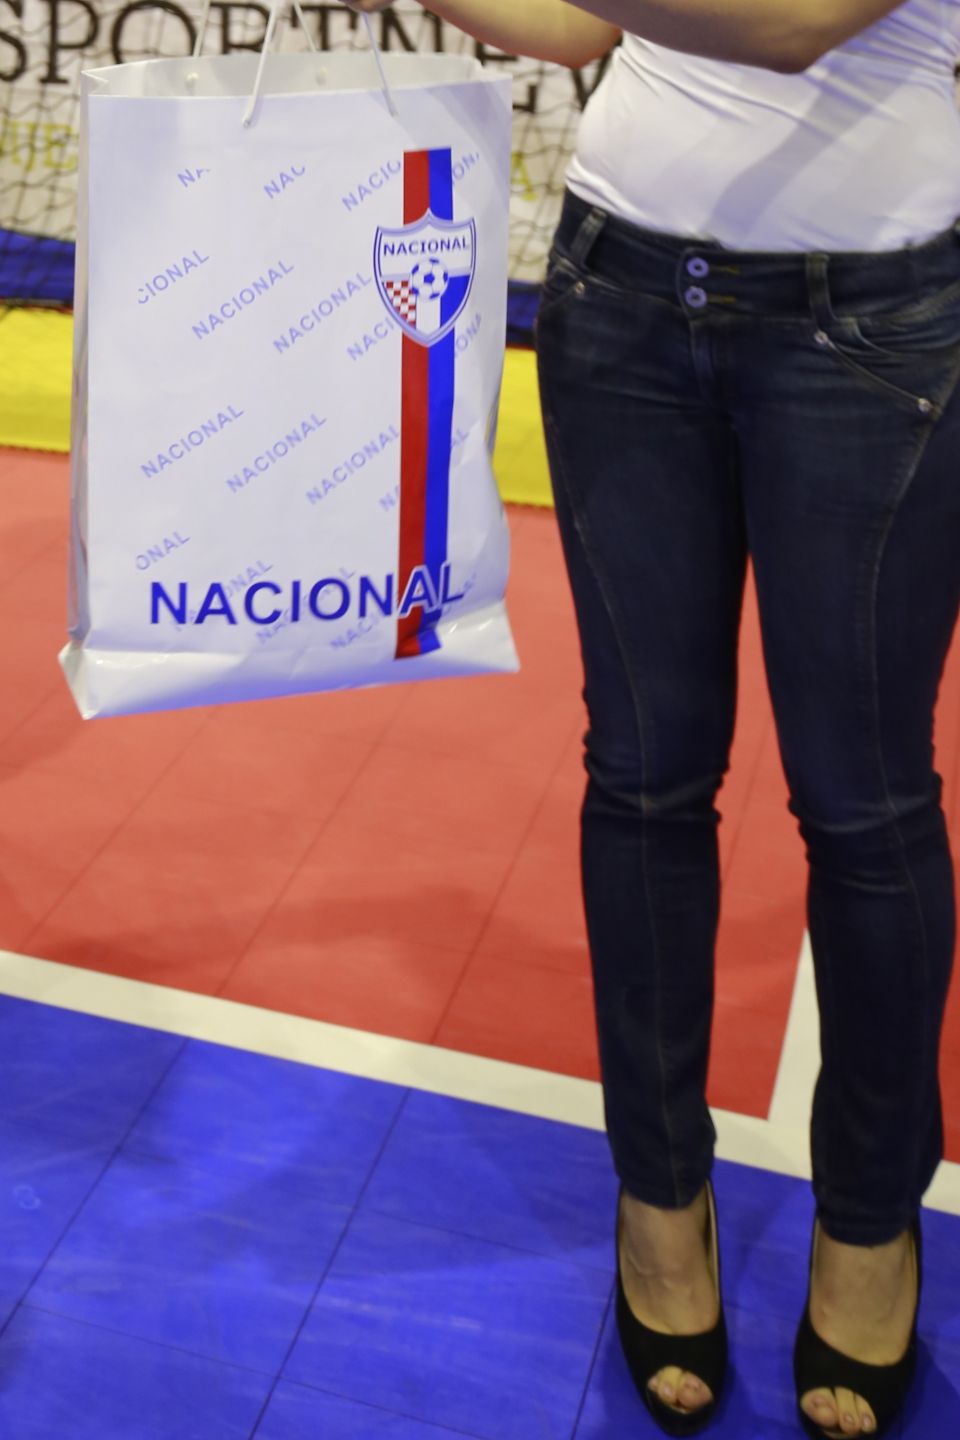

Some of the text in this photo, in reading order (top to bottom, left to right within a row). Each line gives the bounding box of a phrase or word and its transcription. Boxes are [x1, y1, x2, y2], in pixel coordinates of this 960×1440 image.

[383, 235, 470, 257] NACIONAL
[192, 259, 295, 340] NACIONAL
[273, 271, 372, 354] NACIONAL
[141, 404, 244, 478] NACIONAL
[226, 412, 327, 493] NACIONAL
[305, 423, 400, 505] NACIONAL
[150, 562, 465, 625] NACIONAL
